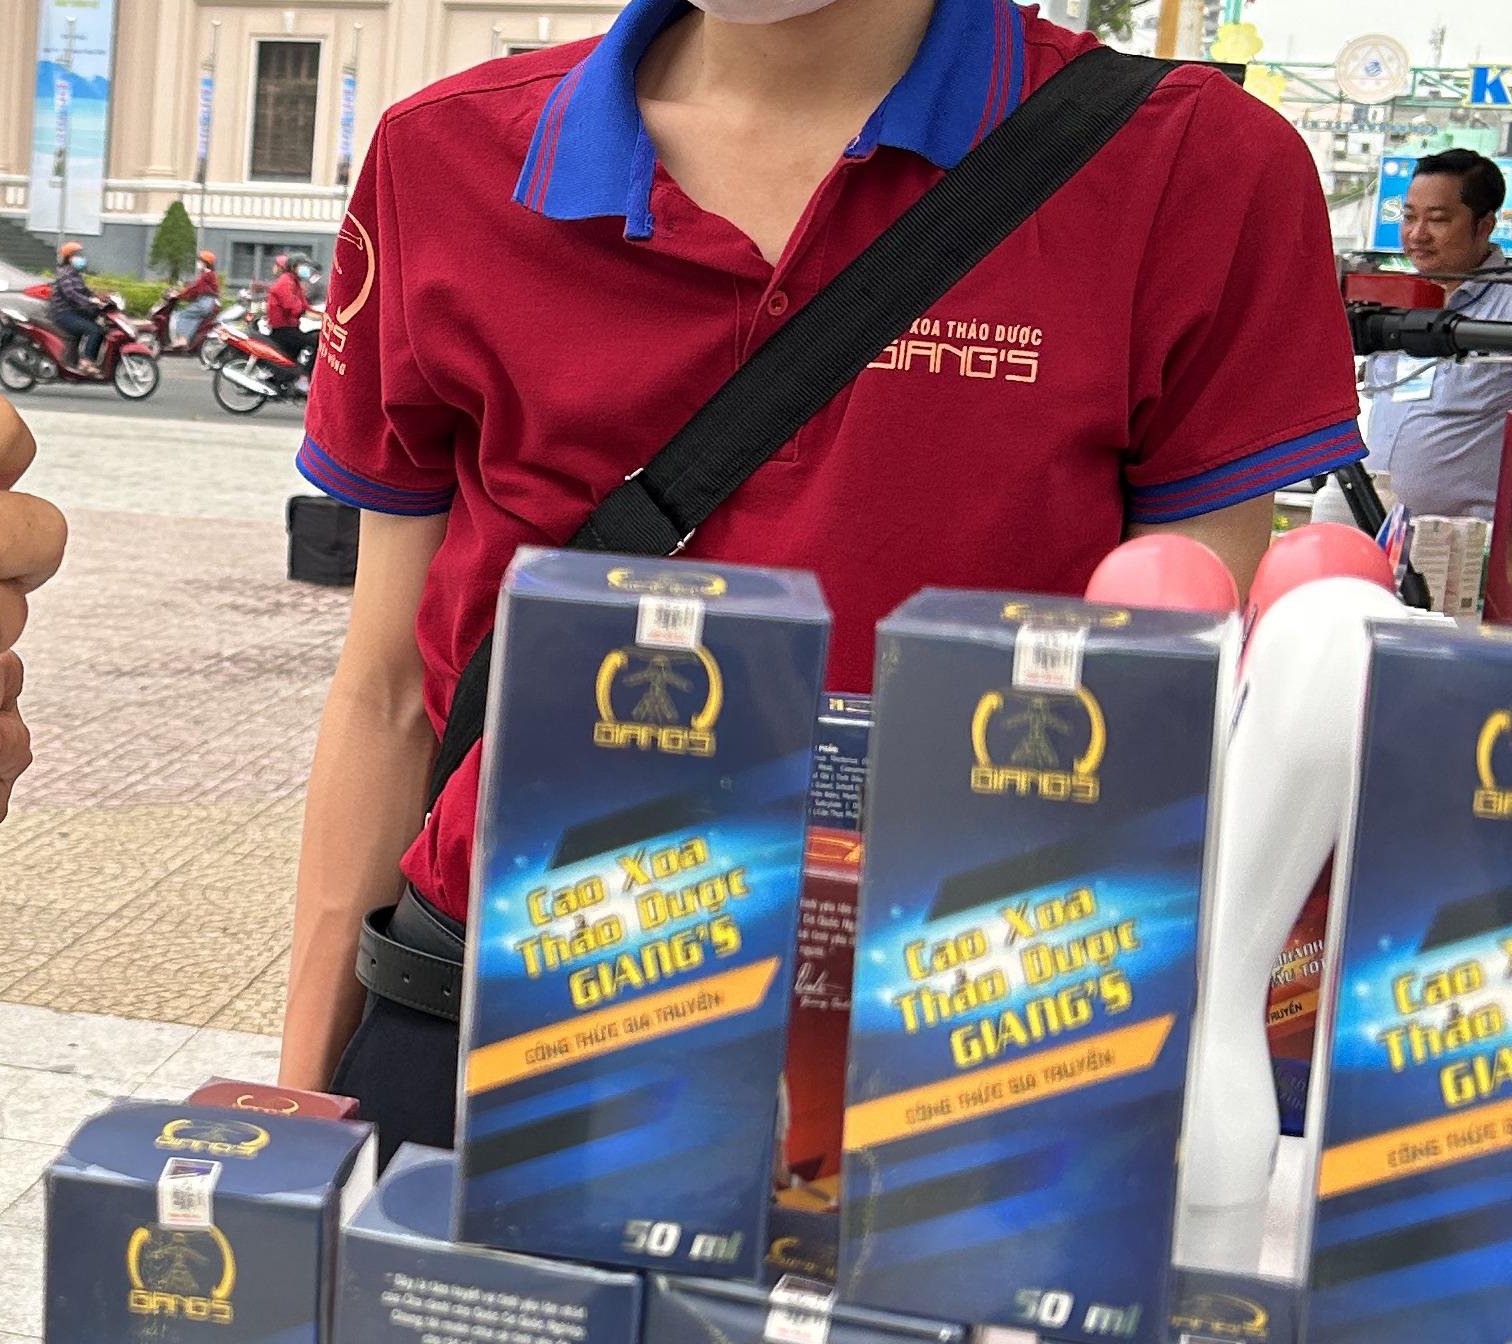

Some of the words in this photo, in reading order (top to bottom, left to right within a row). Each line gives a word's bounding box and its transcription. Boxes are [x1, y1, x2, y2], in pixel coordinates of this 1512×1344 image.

[947, 318, 989, 341] THẢO
[995, 324, 1043, 348] DƯỢC
[527, 872, 607, 926] Cao
[619, 835, 708, 889] Xoa
[518, 912, 623, 975] Thảo
[568, 913, 741, 1008] GIANG'S
[905, 927, 987, 980] Cao
[1000, 885, 1096, 945] Xoa
[895, 967, 1008, 1032] Thảo
[949, 968, 1133, 1066] GIANG'S
[1392, 957, 1485, 1016] Cao
[622, 1219, 681, 1257] 50
[689, 1231, 744, 1264] ml
[1013, 1287, 1074, 1327] 50
[1083, 1298, 1142, 1337] ml
